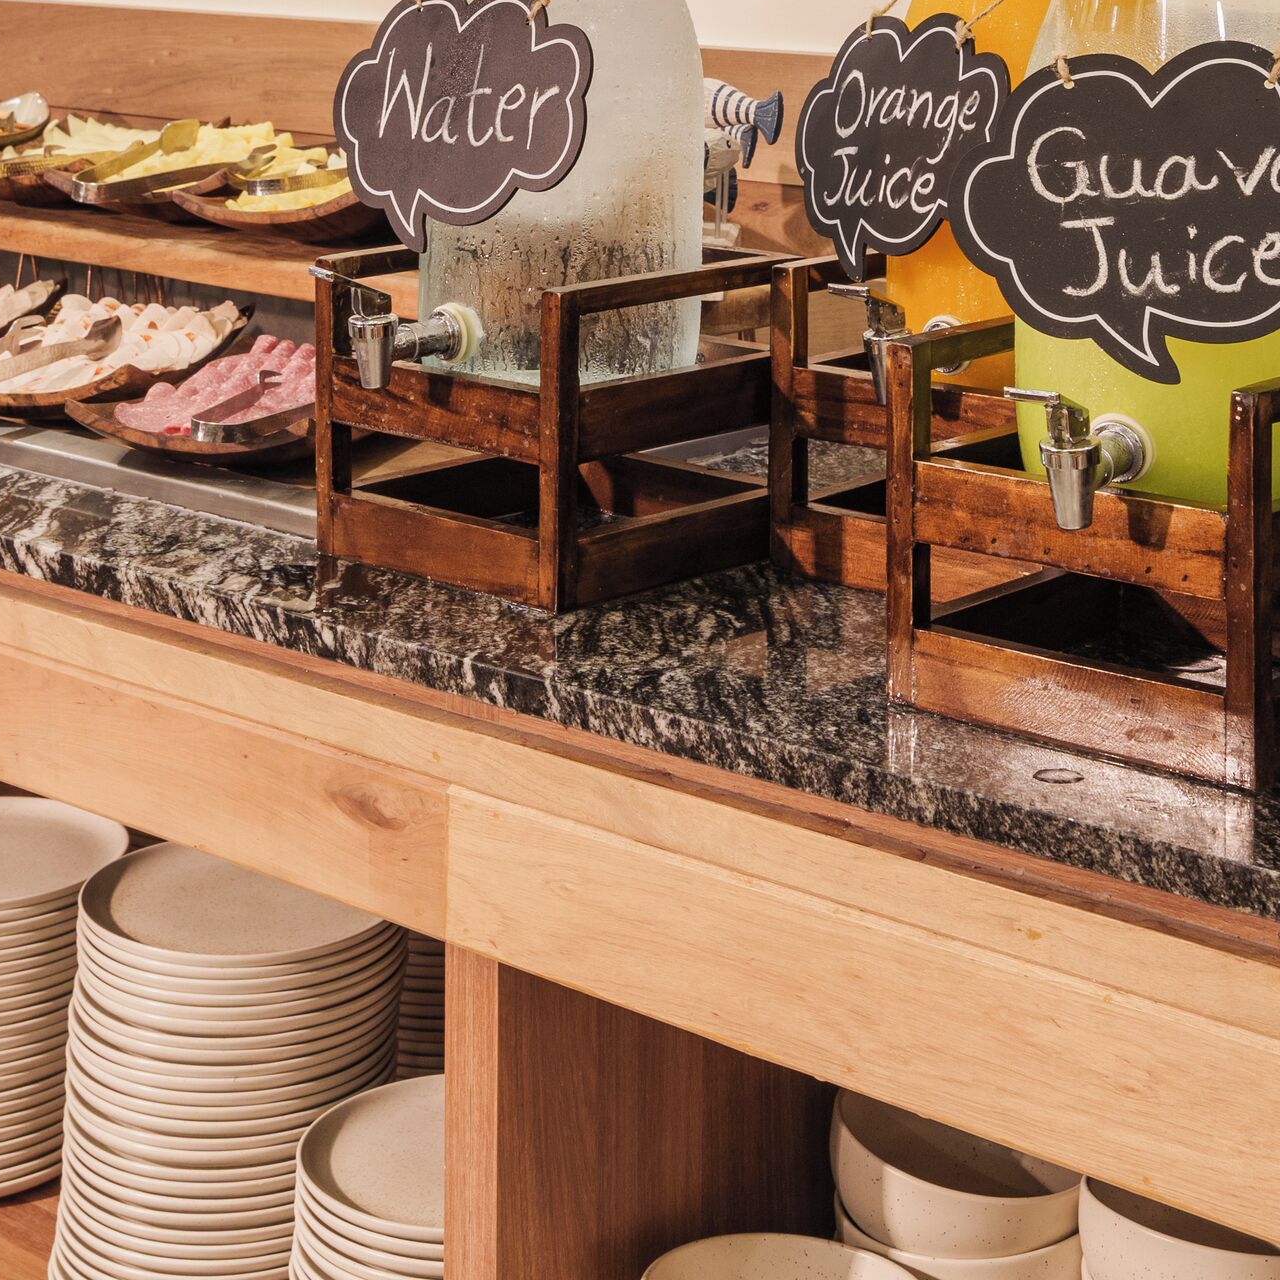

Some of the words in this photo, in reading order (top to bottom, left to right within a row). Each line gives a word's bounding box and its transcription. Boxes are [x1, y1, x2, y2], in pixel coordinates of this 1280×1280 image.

[376, 42, 560, 151] Water
[834, 69, 979, 163] Orange
[823, 145, 941, 215] Juice
